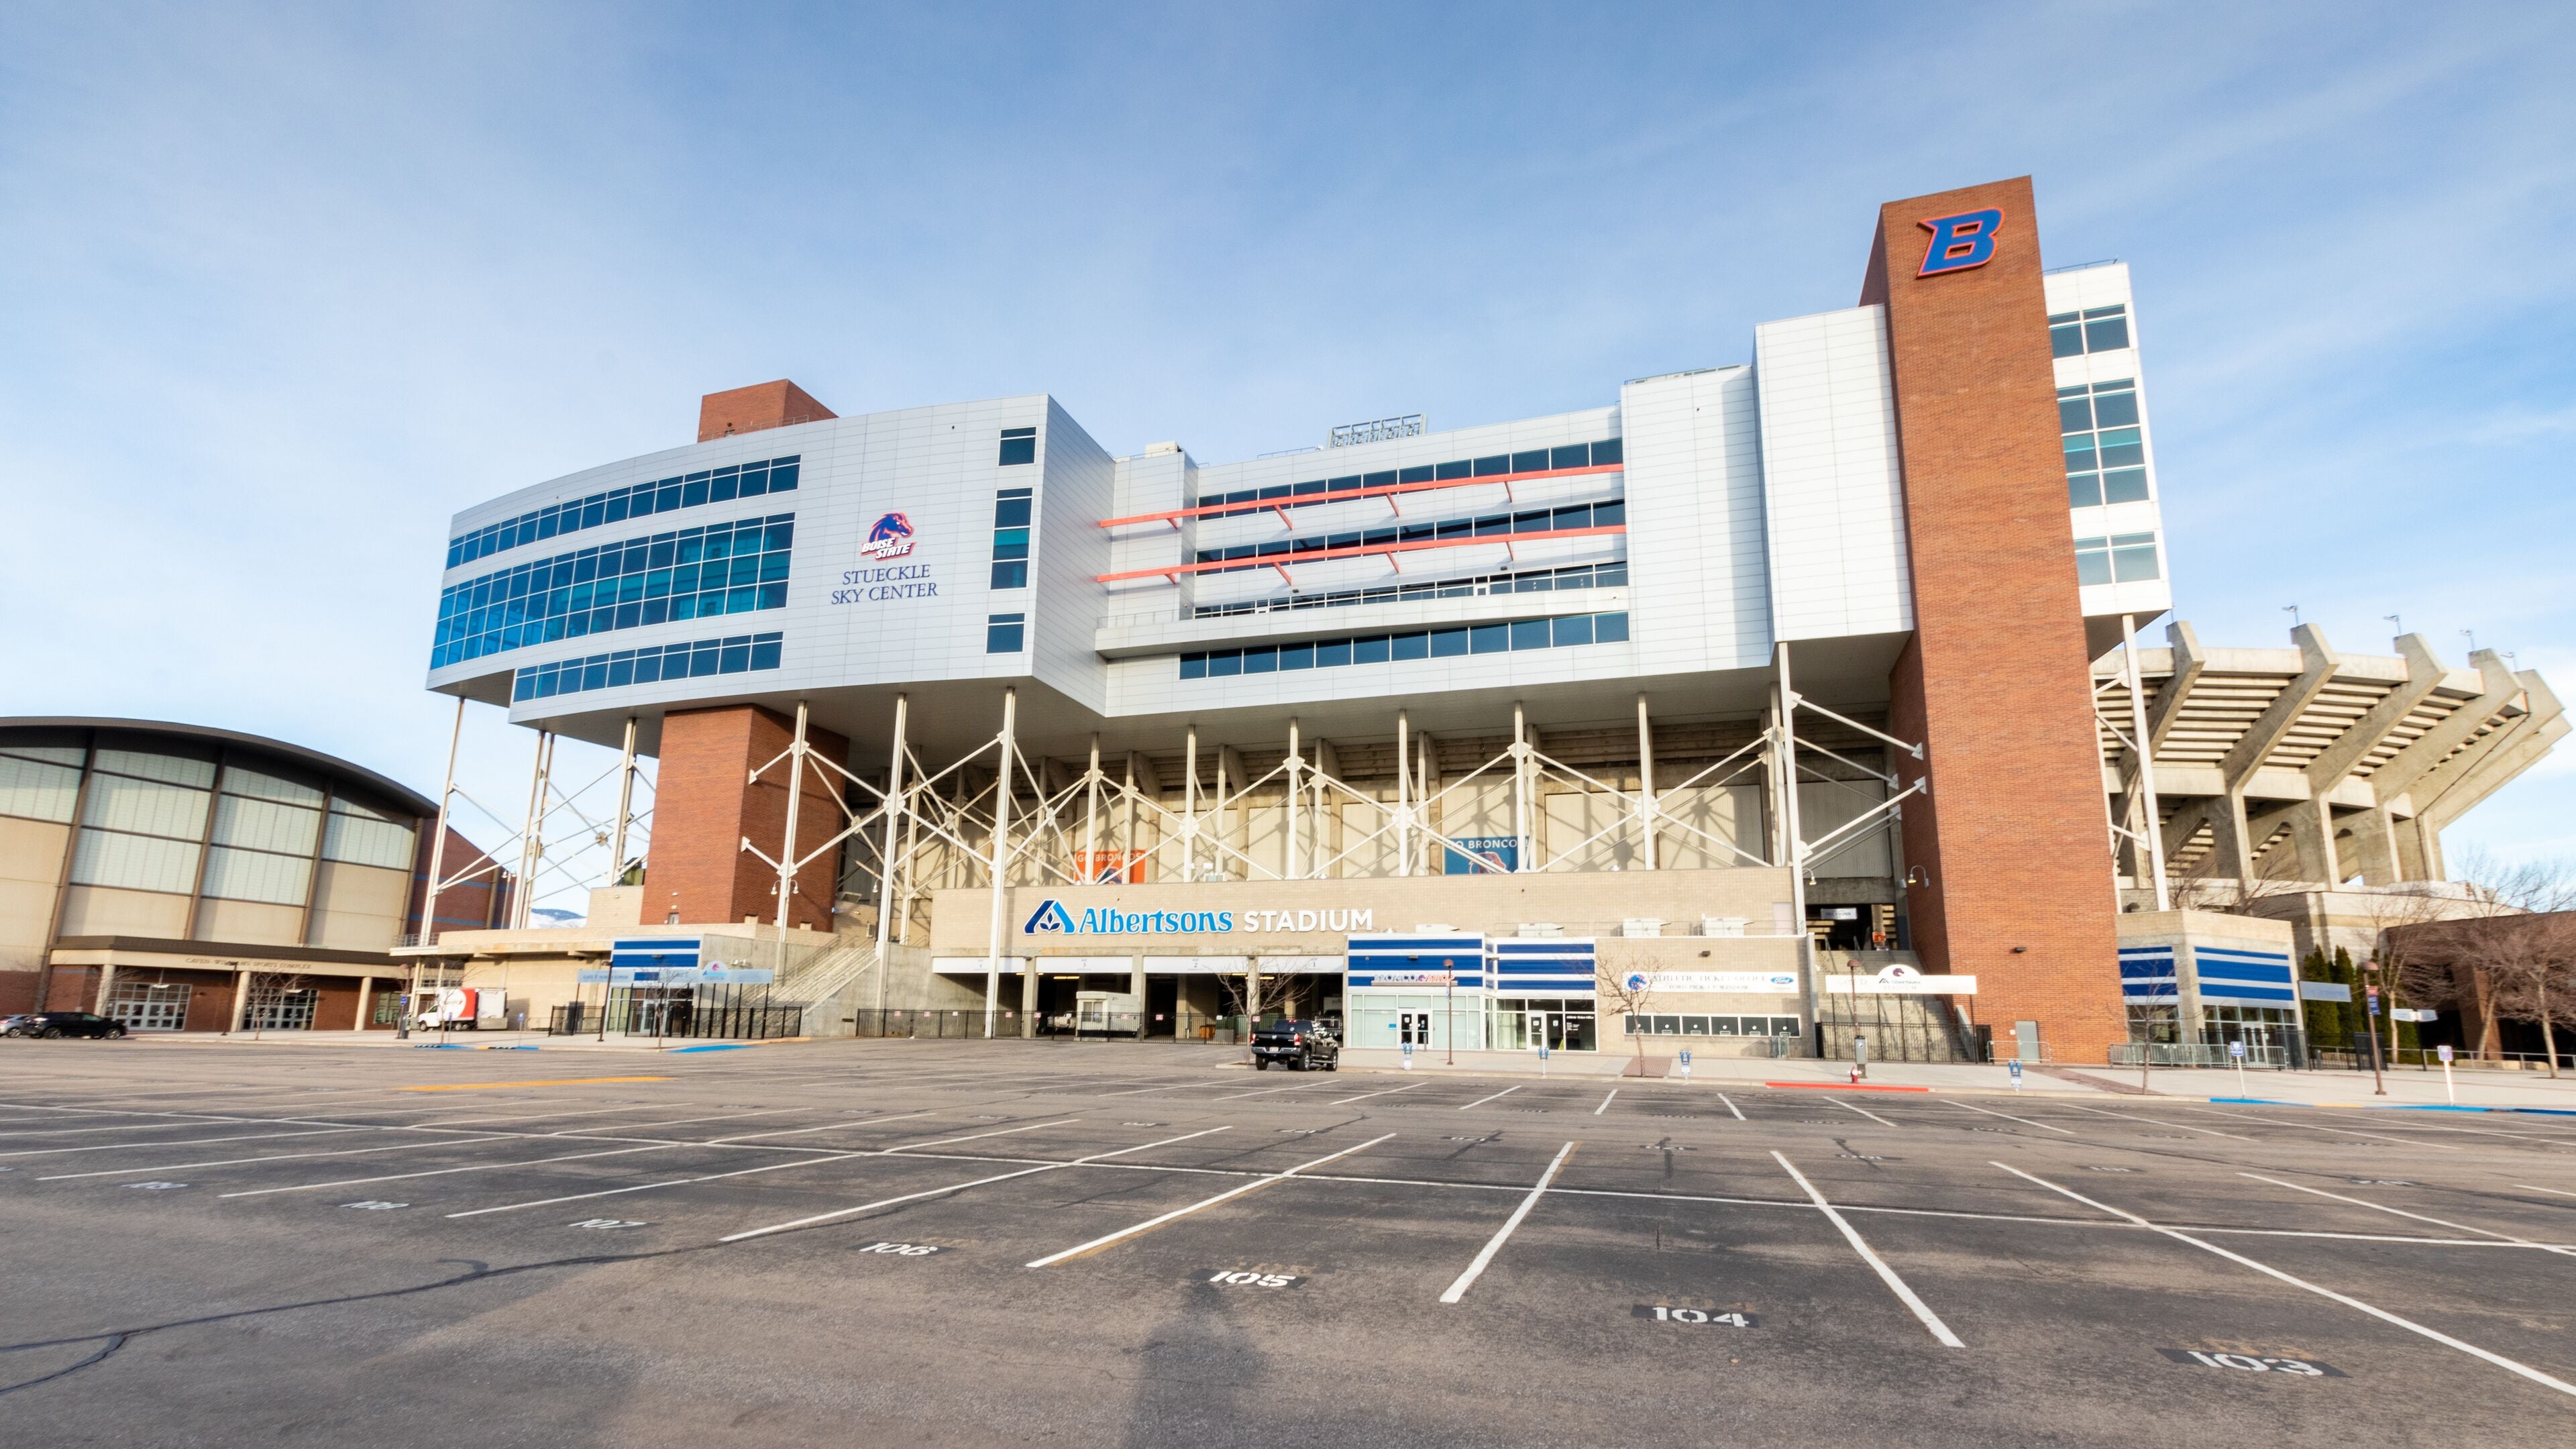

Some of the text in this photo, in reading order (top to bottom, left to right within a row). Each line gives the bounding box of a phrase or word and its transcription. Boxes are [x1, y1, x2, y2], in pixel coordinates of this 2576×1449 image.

[1917, 207, 2006, 277] B
[861, 537, 896, 553] BOISE
[875, 543, 912, 559] STATE
[843, 564, 930, 585] STUECKLE
[831, 582, 938, 604] SKY CENTER
[1079, 907, 1373, 934] Albertsons STADIUM
[568, 1219, 647, 1229] 107
[859, 1242, 938, 1256] 106
[1210, 1271, 1296, 1287] 105
[1652, 1306, 1750, 1327] 104
[2187, 1350, 2324, 1376] 103
